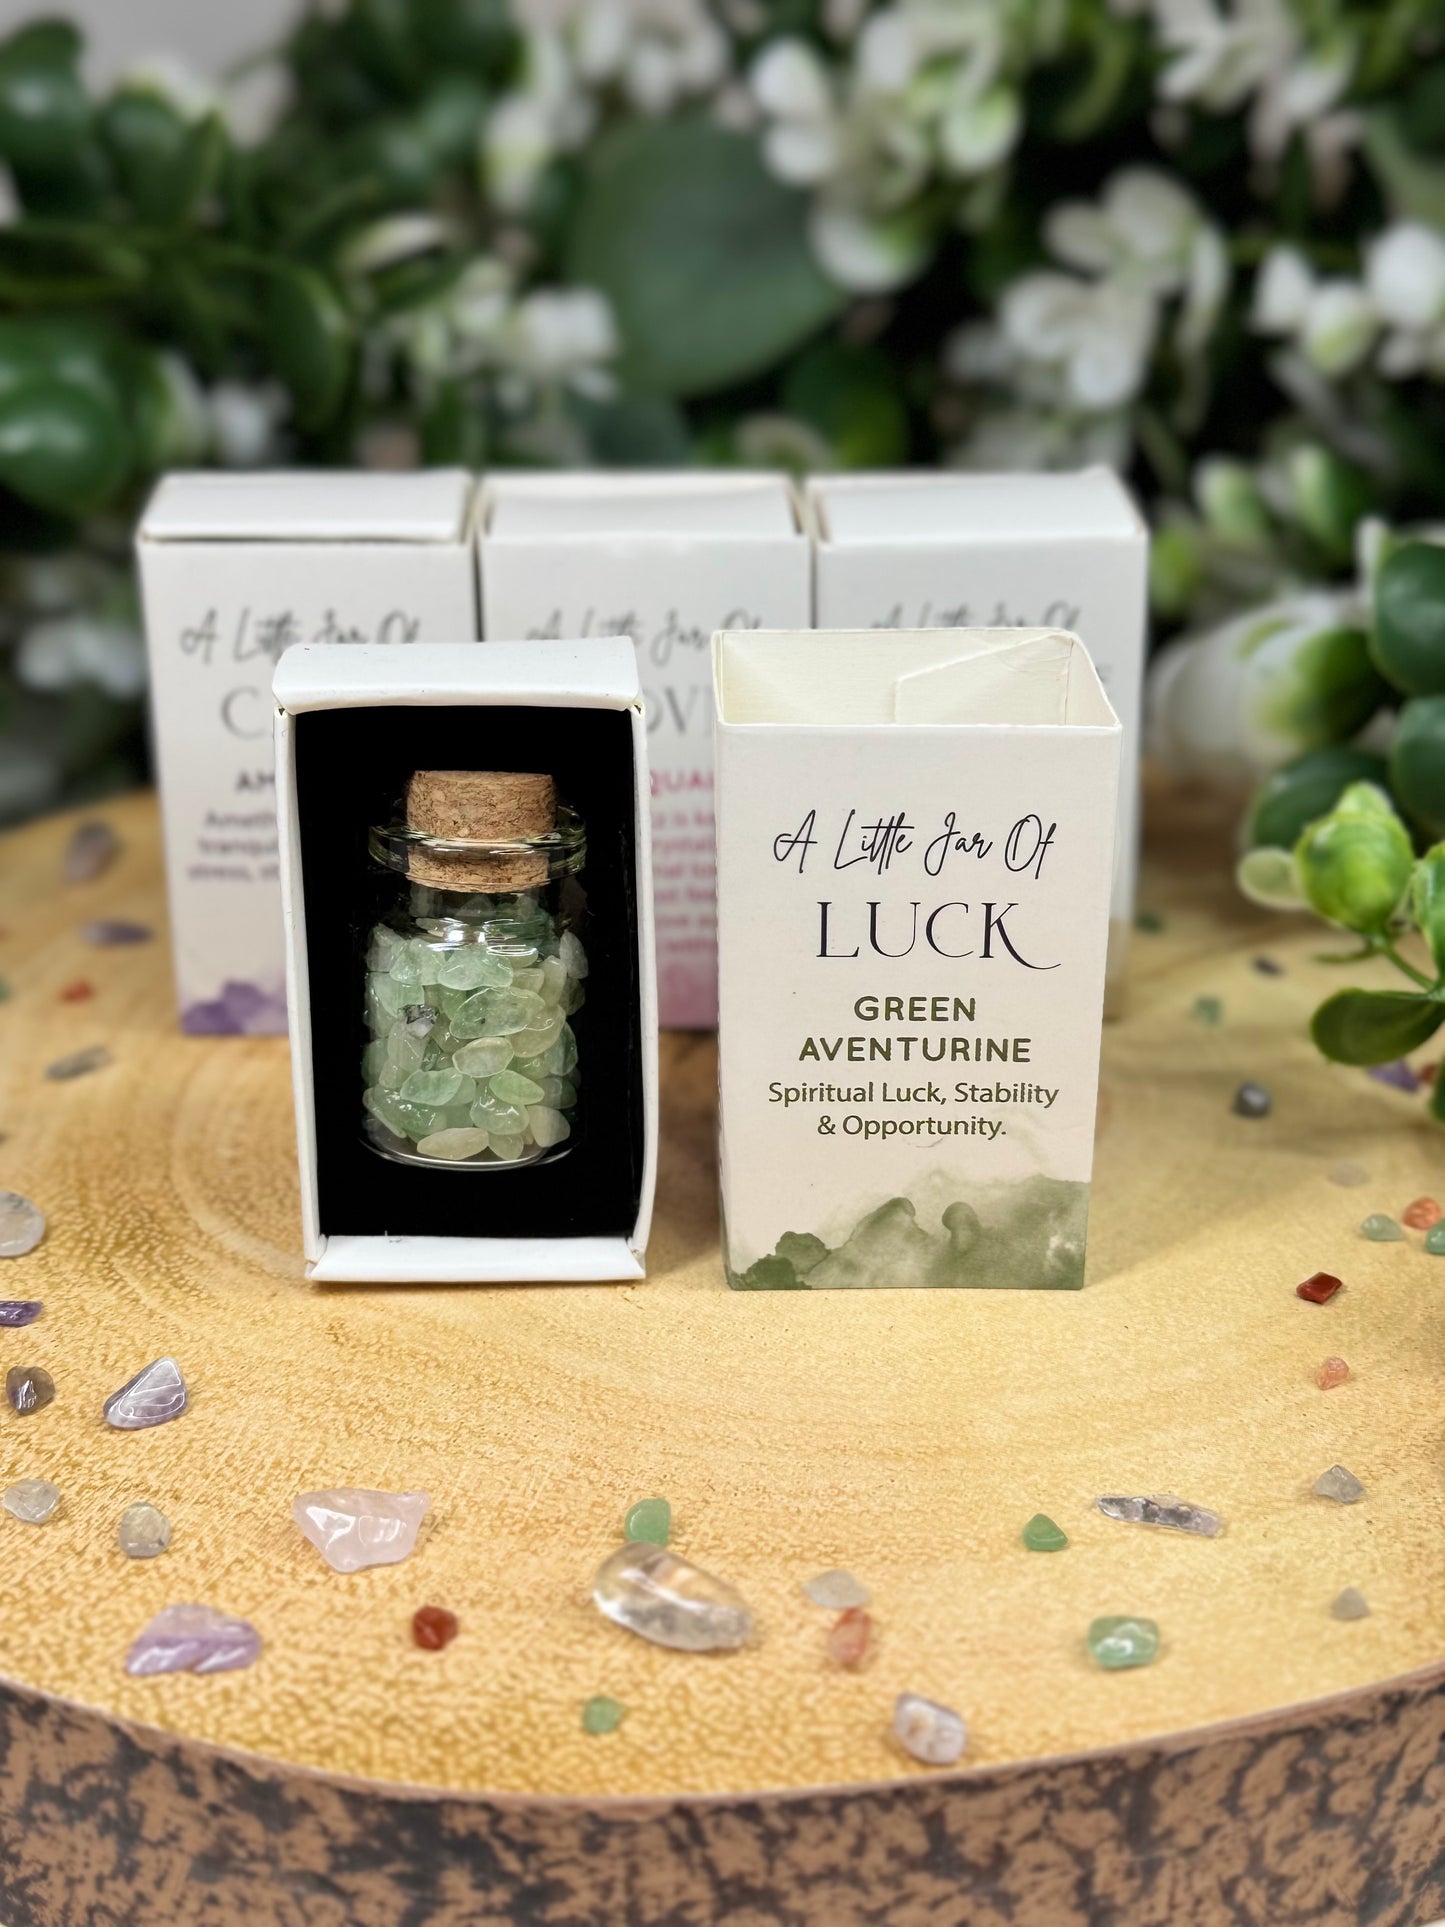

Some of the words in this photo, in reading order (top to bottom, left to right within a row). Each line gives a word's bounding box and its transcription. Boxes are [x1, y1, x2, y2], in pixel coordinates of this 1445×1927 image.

[773, 809, 818, 874] A
[833, 808, 915, 876] Little
[923, 811, 994, 877] Jar
[1004, 813, 1057, 880] Of
[815, 901, 1062, 970] LUCK
[853, 995, 976, 1022] GREEN
[798, 1036, 1032, 1063] AVENTURINE
[768, 1081, 874, 1108] Spiritual
[882, 1081, 947, 1106] Luck,
[954, 1082, 1060, 1109] Stability
[817, 1115, 836, 1136] &
[842, 1115, 1007, 1141] Opportunity.
